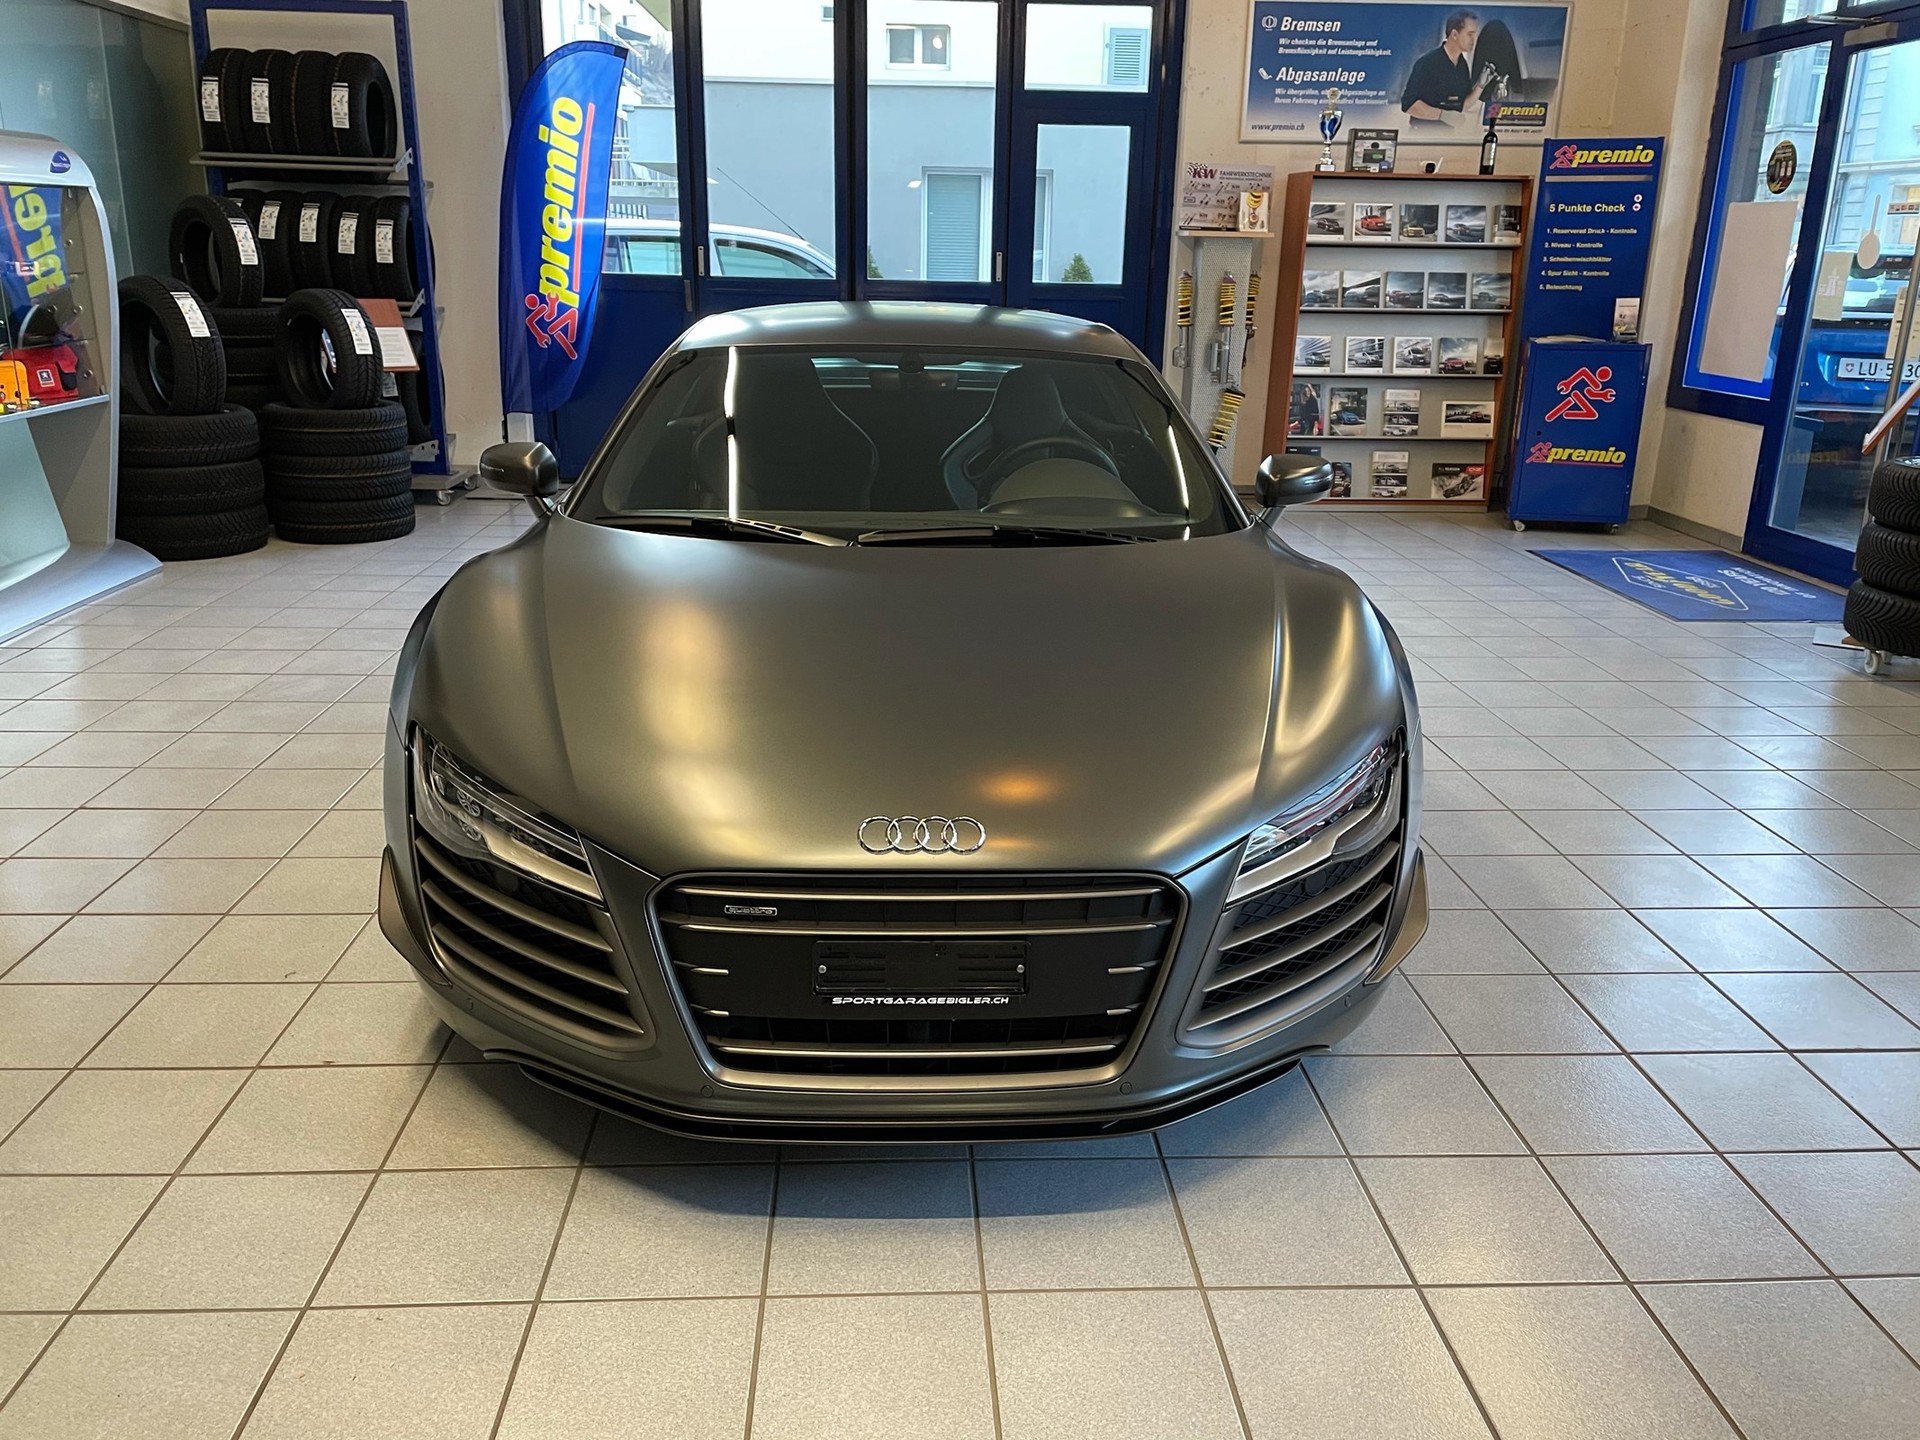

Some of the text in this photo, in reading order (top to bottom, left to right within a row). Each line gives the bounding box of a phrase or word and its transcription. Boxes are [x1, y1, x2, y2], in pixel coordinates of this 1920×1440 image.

[1281, 16, 1341, 32] Bremsen
[1276, 67, 1365, 85] Abgasanlage
[1498, 104, 1545, 119] premio
[1251, 122, 1305, 131] www.premio.ch
[1571, 145, 1655, 168] premio
[1192, 168, 1217, 179] KW
[539, 96, 584, 308] premio
[1549, 203, 1625, 212] 5 Punkte Check
[1547, 447, 1626, 464] premio
[832, 997, 1009, 1005] SPORTGARAGEBIGLER.CH
